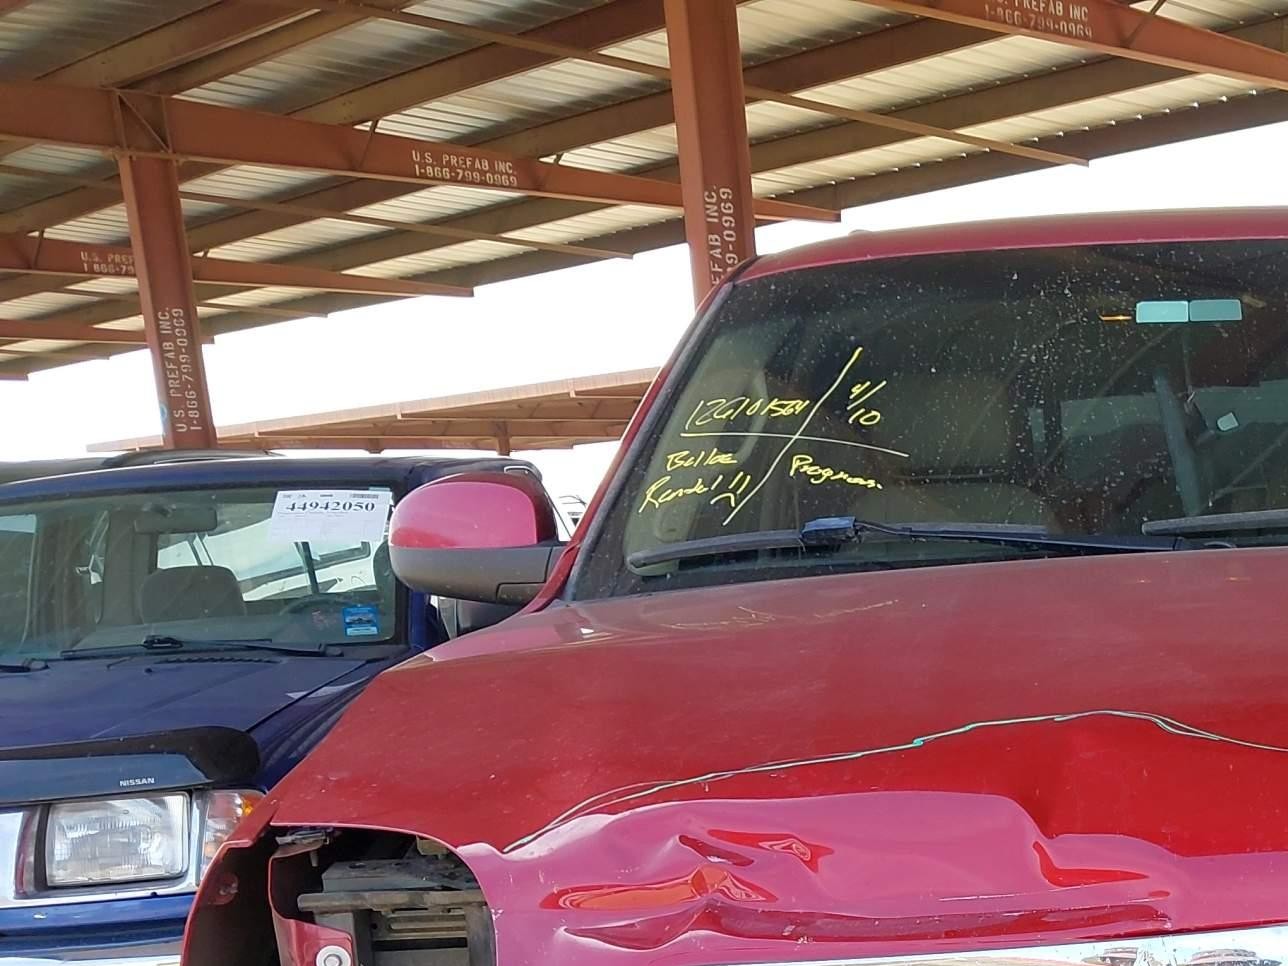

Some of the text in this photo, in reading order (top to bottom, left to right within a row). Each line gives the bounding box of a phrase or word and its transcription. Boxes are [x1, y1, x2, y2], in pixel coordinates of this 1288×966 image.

[412, 150, 518, 175] U.S. PREFAB INC.
[415, 164, 518, 187] 1-866-799-0969
[703, 185, 719, 223] INC.
[158, 307, 173, 334] INC.
[163, 341, 183, 397] PREFAB
[286, 501, 376, 512] 44942050
[119, 777, 155, 786] NISSAN
